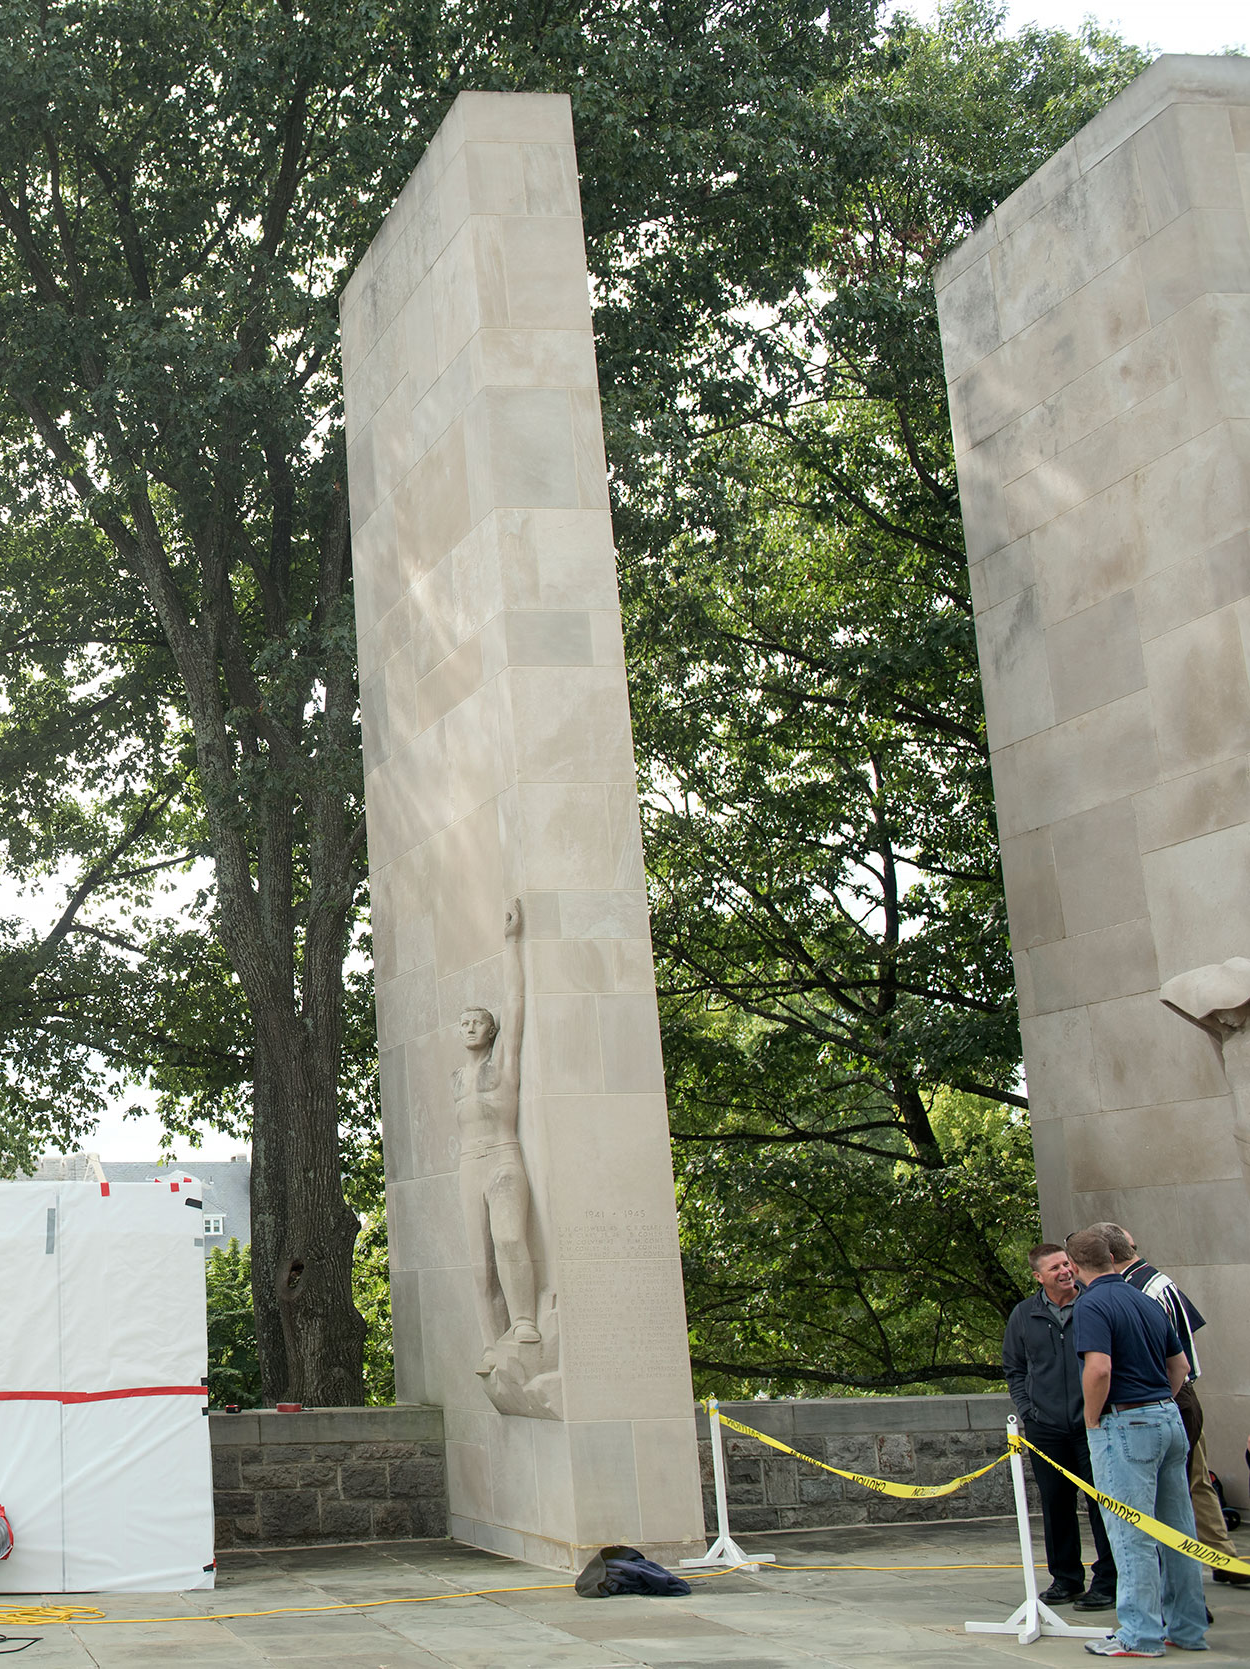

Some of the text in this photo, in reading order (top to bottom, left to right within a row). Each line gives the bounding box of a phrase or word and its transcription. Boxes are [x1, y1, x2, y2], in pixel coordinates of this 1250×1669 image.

[585, 1209, 646, 1219] 1941 1945
[852, 1475, 887, 1493] CAUTION
[1096, 1492, 1141, 1526] CAUTION
[1178, 1538, 1232, 1568] CAUTION
